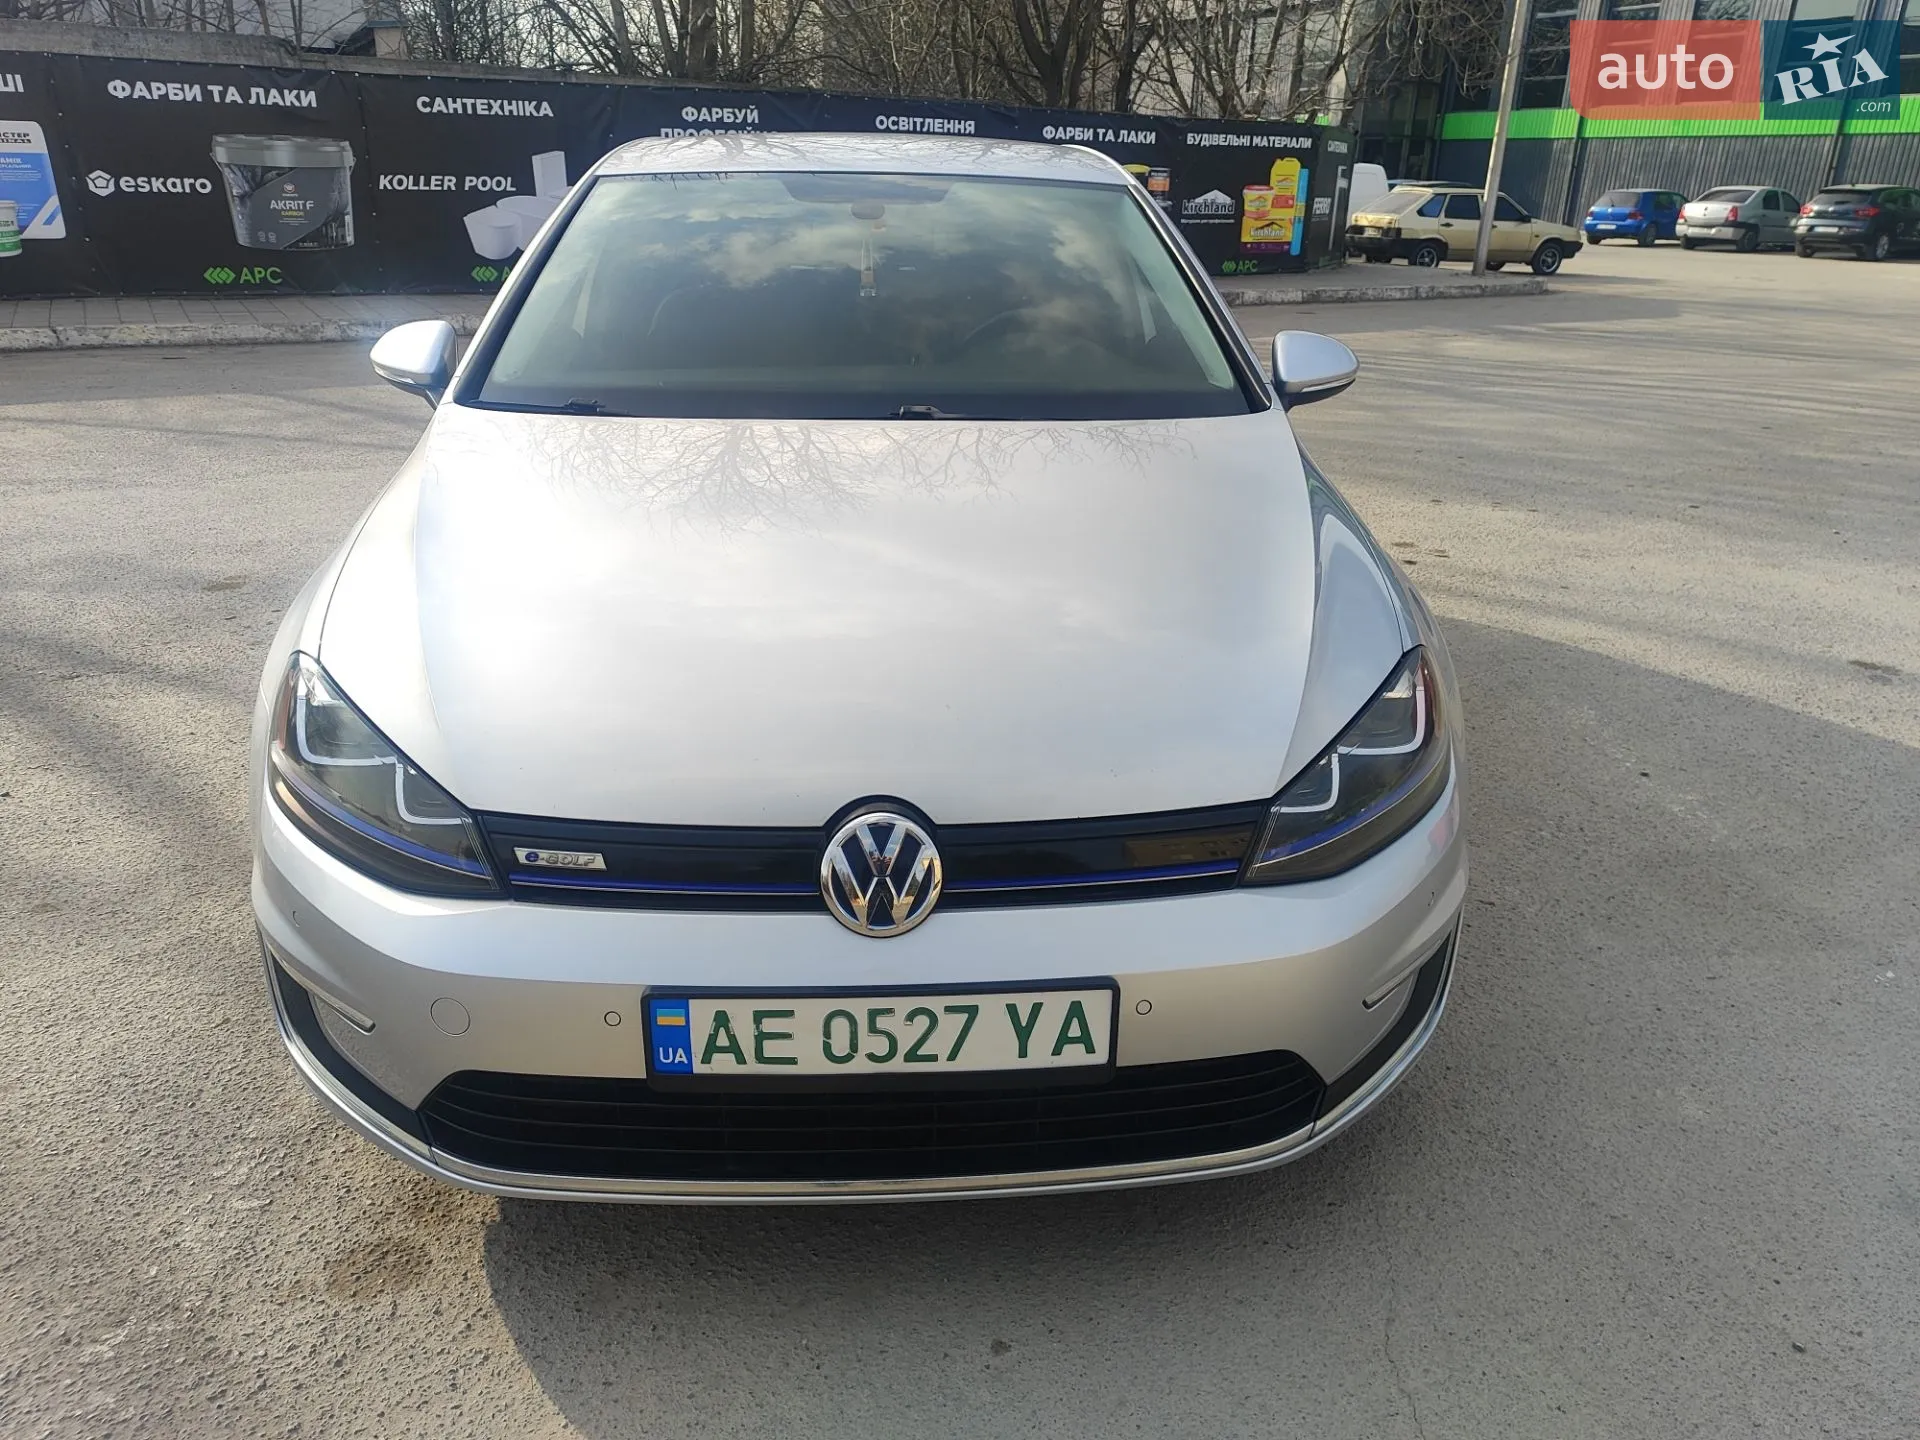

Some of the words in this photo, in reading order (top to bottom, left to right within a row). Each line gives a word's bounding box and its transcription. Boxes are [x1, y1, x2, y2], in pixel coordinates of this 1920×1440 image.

[107, 79, 203, 102] ФАРБИ
[207, 84, 244, 104] ТА
[248, 87, 318, 108] ЛАКИ
[416, 96, 554, 118] САНТЕХНІКА
[681, 105, 759, 124] ФАРБУЙ
[875, 115, 976, 134] ОСВІТЛЕННЯ
[1042, 125, 1093, 141] ФАРБИ
[1097, 128, 1116, 142] ТА
[1117, 129, 1156, 145] ЛАКИ
[1186, 132, 1251, 147] БУДІВЕЛЬНІ
[1252, 136, 1313, 149] МАТЕРІАЛИ
[119, 175, 213, 194] eskaro
[378, 174, 457, 190] KOLLER
[464, 176, 517, 191] POOL
[270, 200, 304, 210] AKRIT
[1182, 199, 1235, 214] kirchland
[700, 1009, 799, 1065] AE
[821, 1004, 980, 1065] 0527
[1005, 1000, 1097, 1060] YA
[658, 1046, 689, 1065] UA
